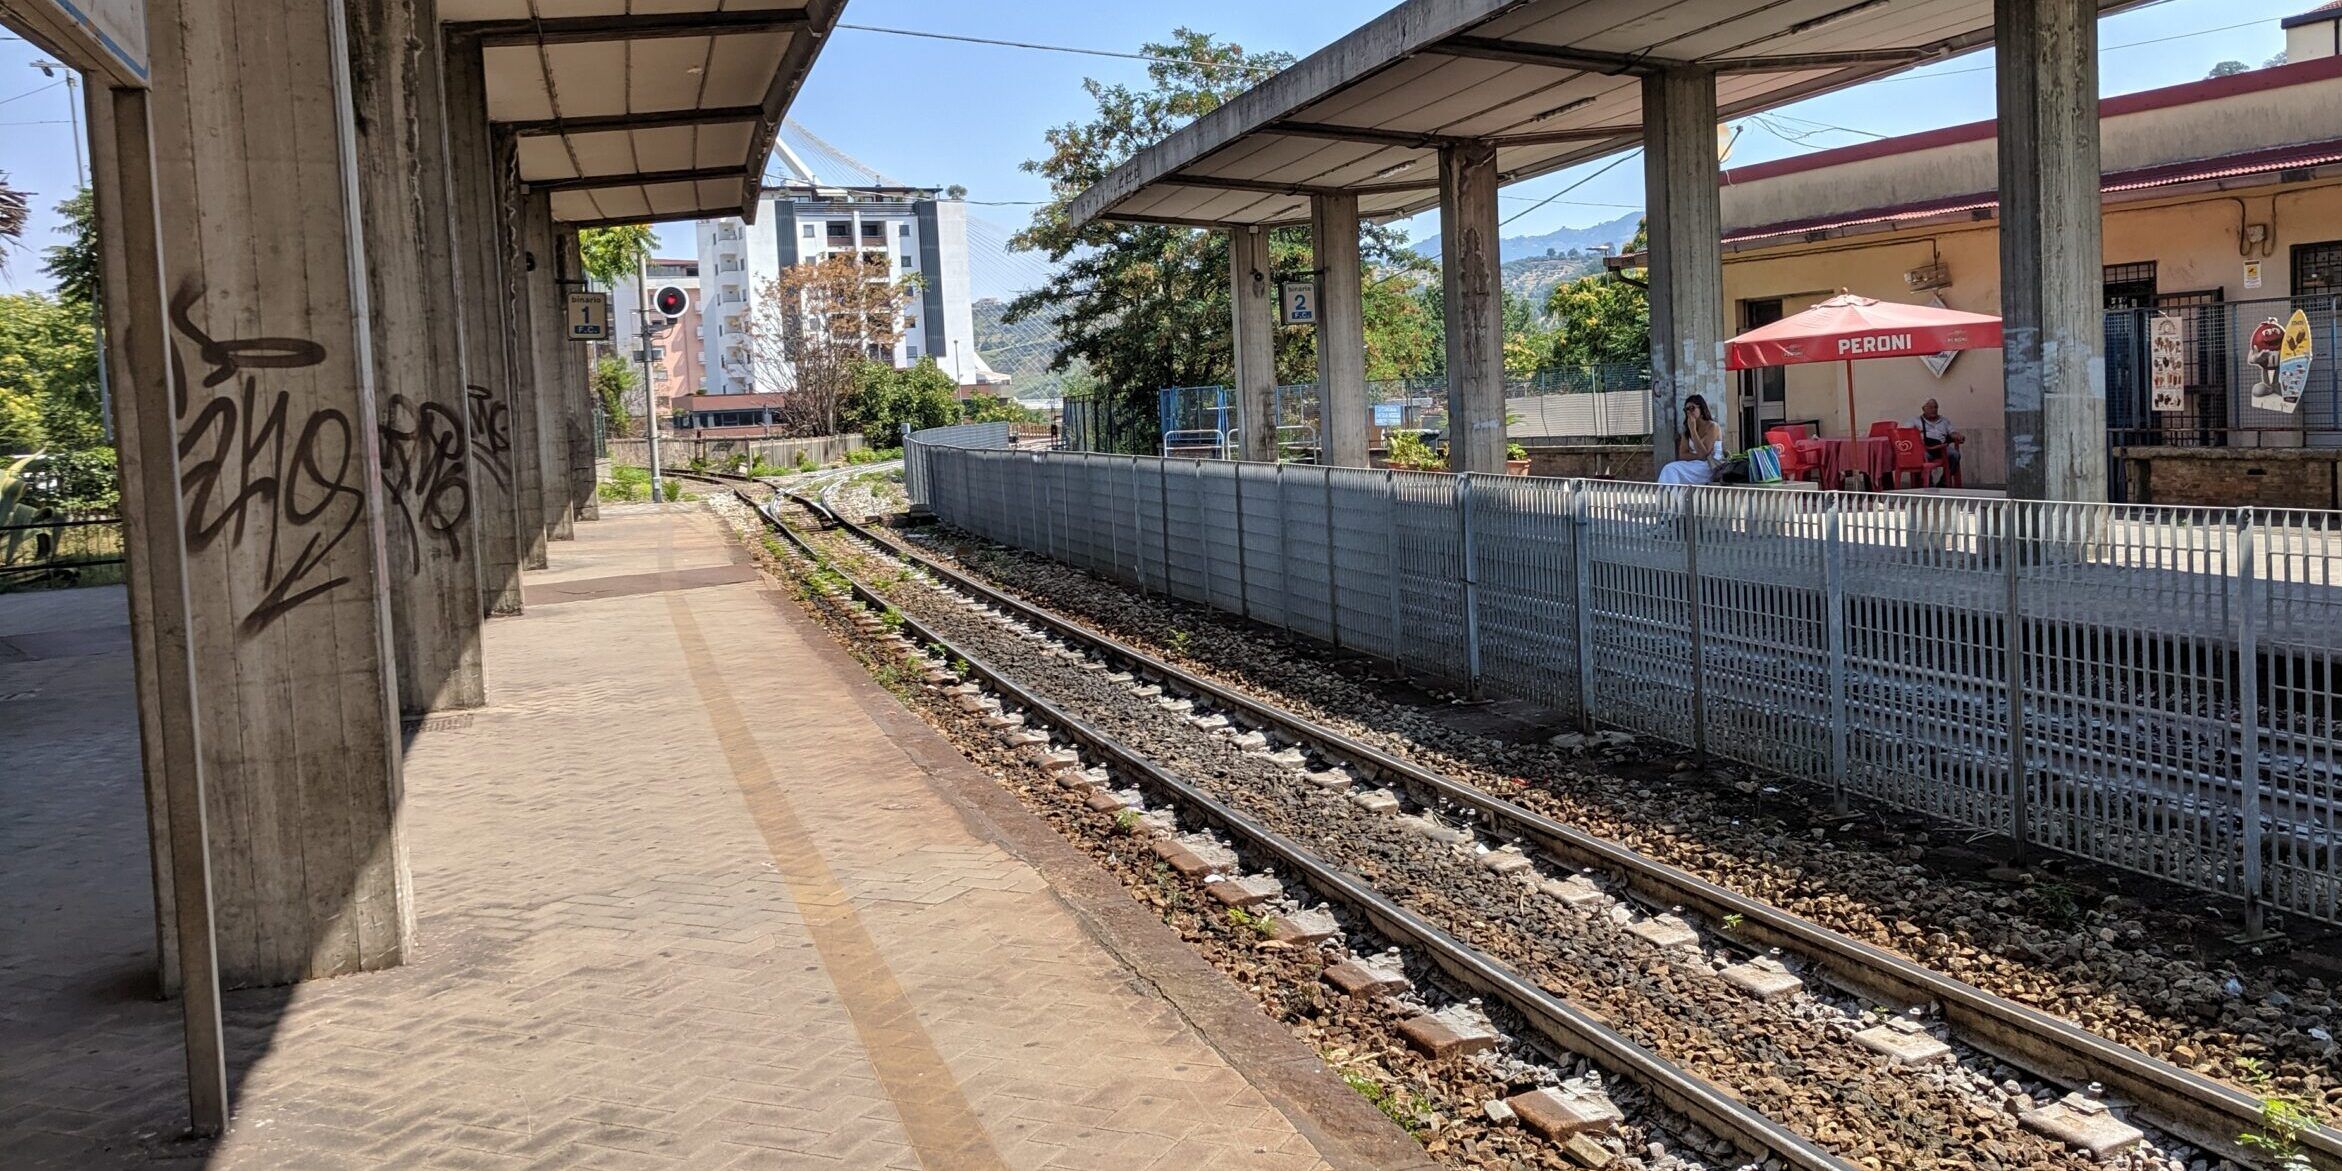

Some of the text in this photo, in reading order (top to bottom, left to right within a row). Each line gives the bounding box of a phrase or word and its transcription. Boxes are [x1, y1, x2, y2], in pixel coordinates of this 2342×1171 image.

[1295, 295, 1306, 310] 2
[582, 306, 590, 324] 1
[1838, 333, 1912, 355] PERONI
